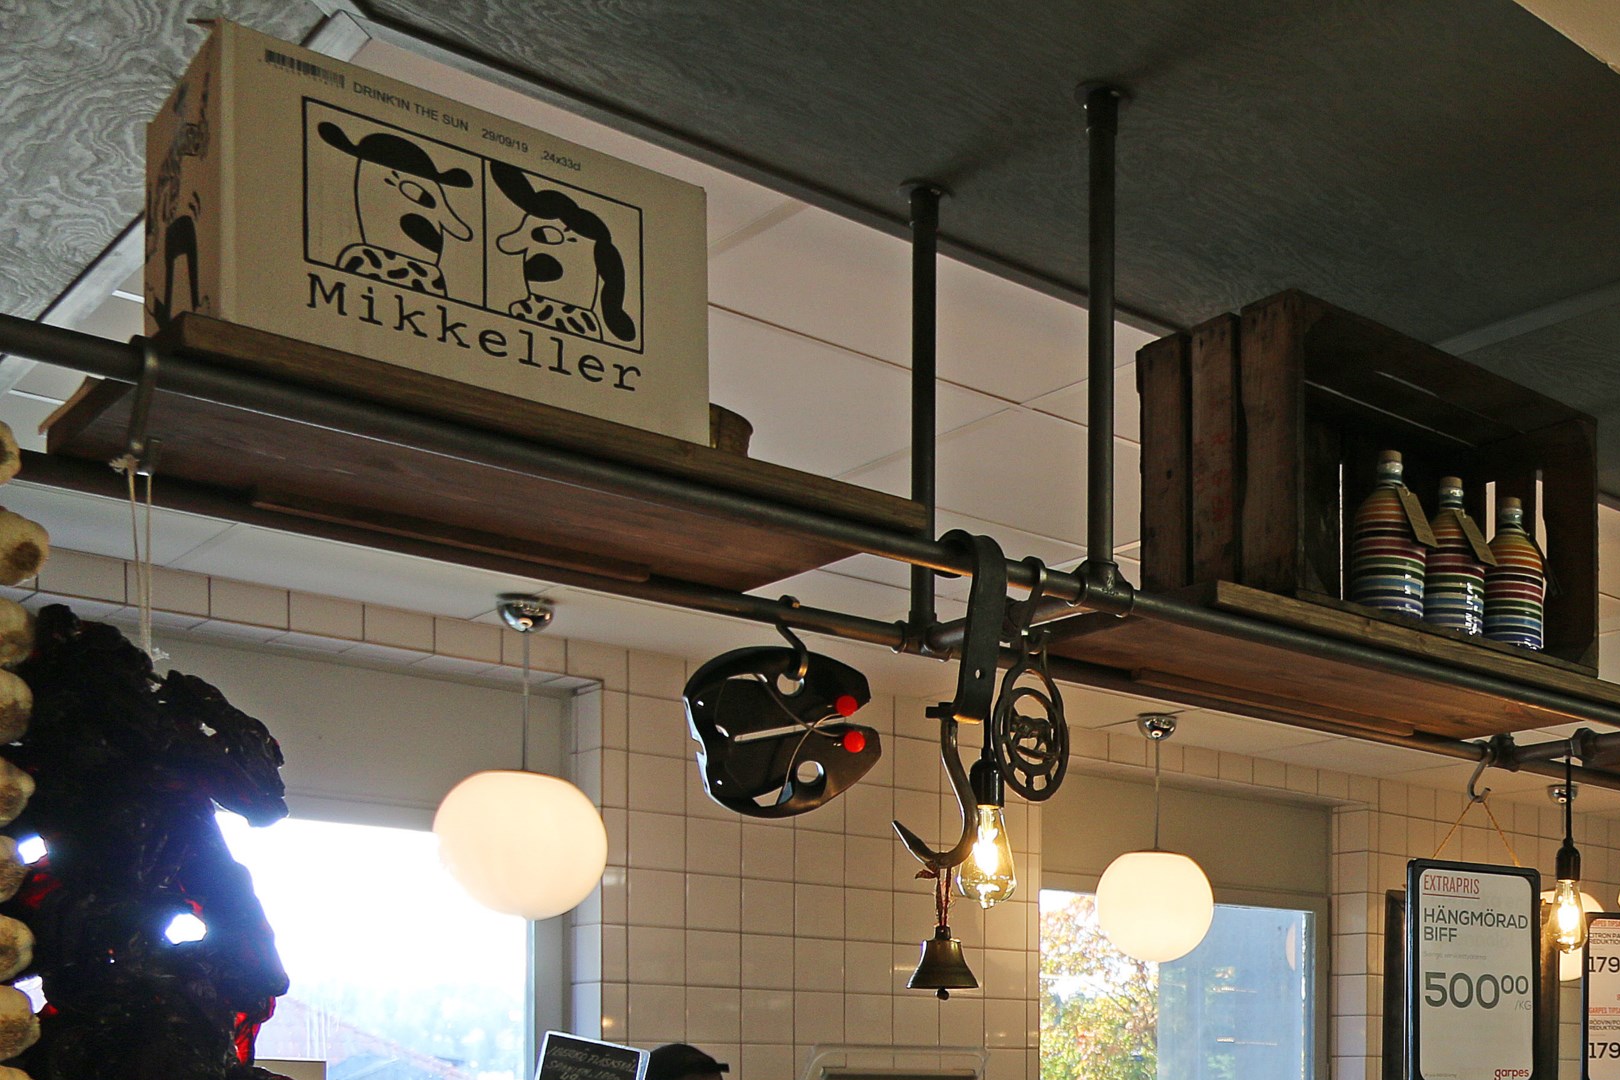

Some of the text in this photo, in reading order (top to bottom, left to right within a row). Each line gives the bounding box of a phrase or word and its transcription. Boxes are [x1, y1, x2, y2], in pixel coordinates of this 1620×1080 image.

[414, 103, 438, 121] THE
[442, 113, 470, 131] SUN
[307, 273, 642, 393] Mikkeller
[1424, 874, 1480, 894] EXTRAPRIS
[1423, 905, 1528, 929] HÄNGMÖRAD
[1423, 927, 1457, 942] BIFF
